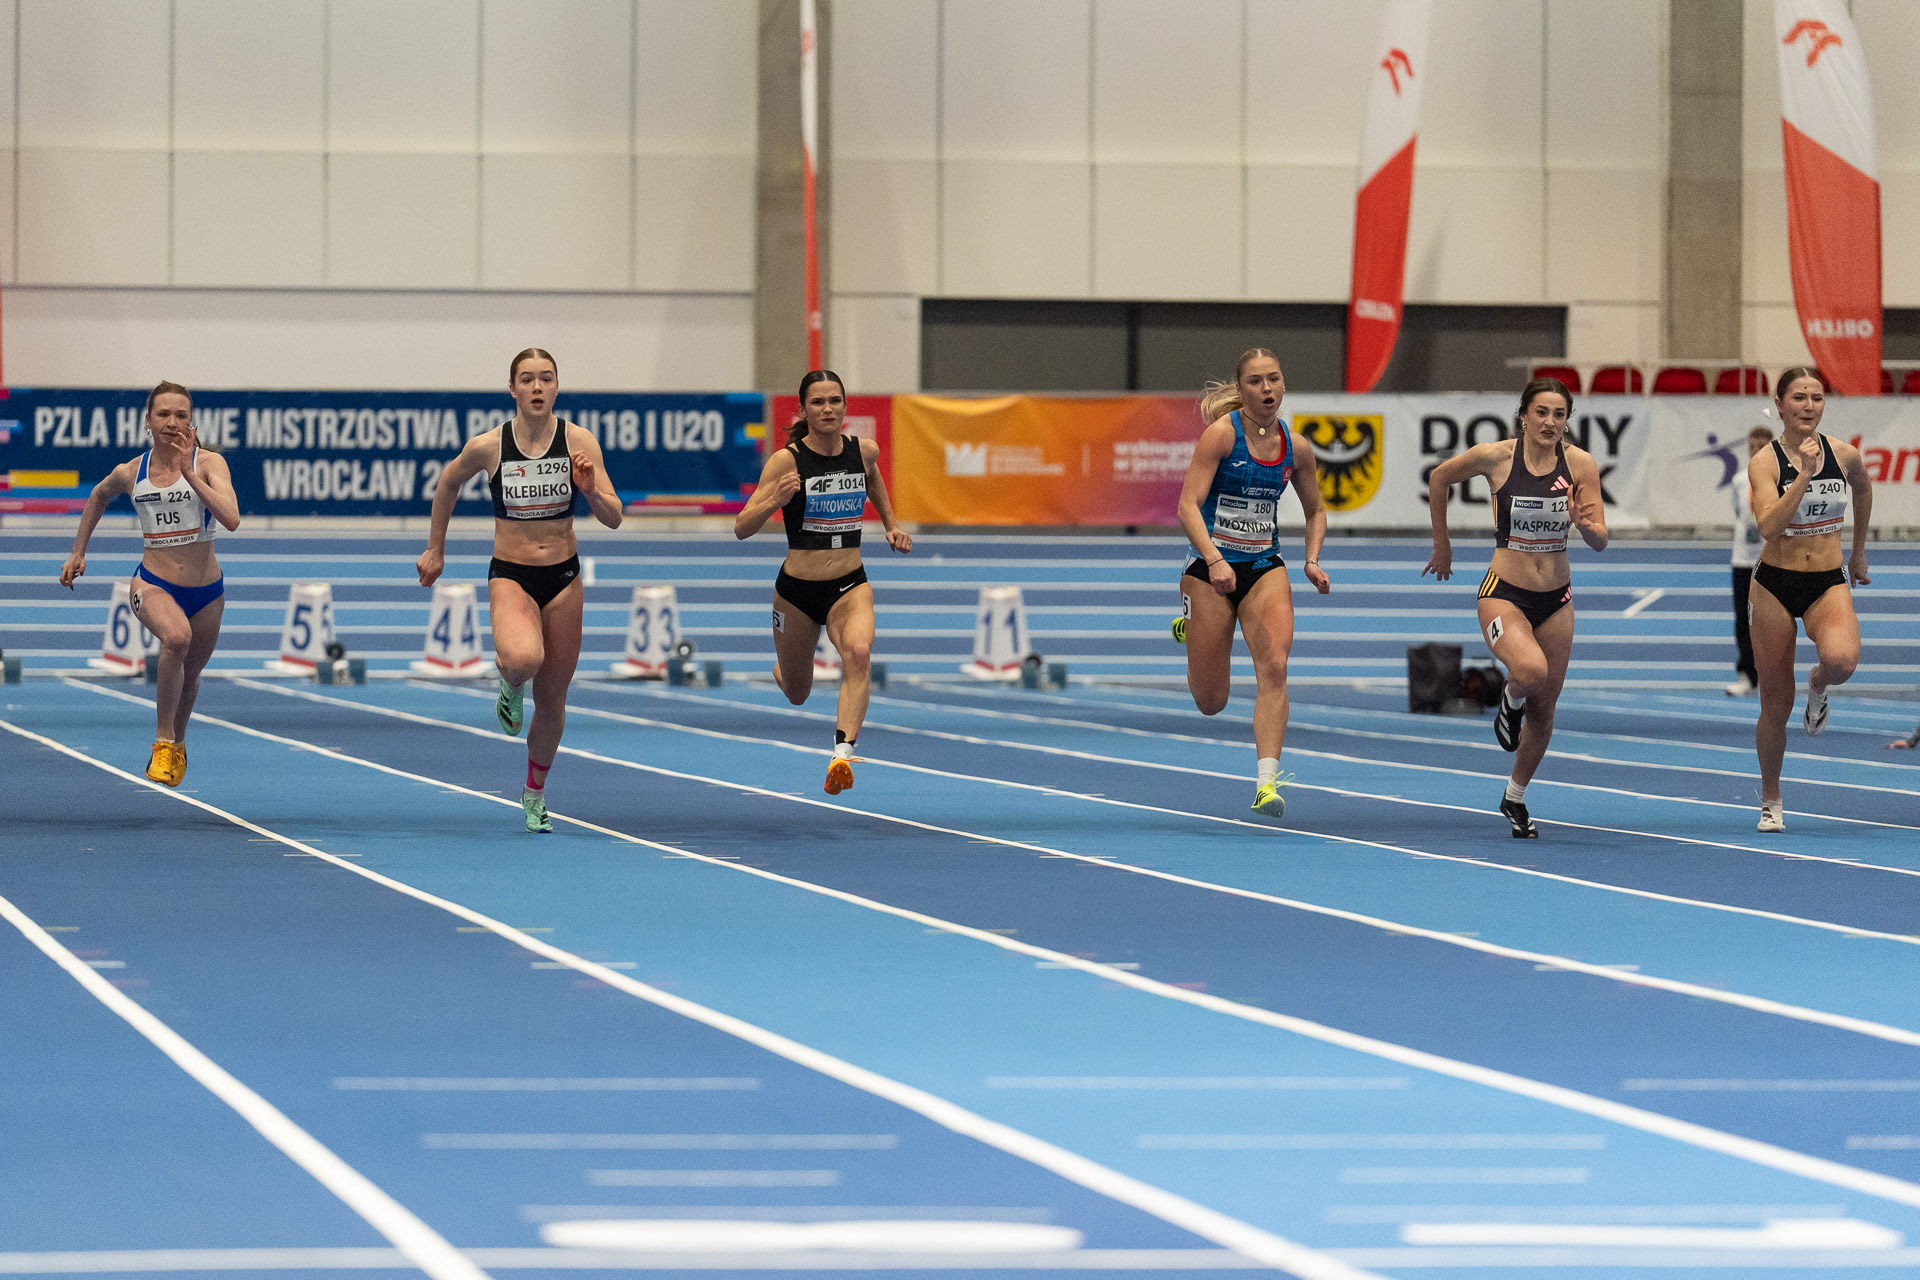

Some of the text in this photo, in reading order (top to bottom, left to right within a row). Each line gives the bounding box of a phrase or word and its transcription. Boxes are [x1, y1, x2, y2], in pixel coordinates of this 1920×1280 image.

[34, 406, 109, 447] PZLA
[116, 407, 241, 448] HAWE
[246, 408, 460, 449] MISTRZOSTWA
[645, 410, 656, 451] I
[662, 410, 725, 451] U20
[536, 461, 569, 475] 1296
[263, 459, 416, 500] WROCŁAW
[838, 477, 865, 491] 1014
[1819, 482, 1841, 495] 240
[168, 490, 191, 503] 224
[505, 482, 569, 499] KLEBIEKO
[1241, 486, 1281, 497] VECTRA
[808, 497, 862, 513] ŻUKOWSKA
[1254, 502, 1271, 514] 180
[1806, 500, 1828, 516] JEŻ
[156, 511, 181, 526] FUS
[133, 593, 140, 612] 8
[1183, 595, 1189, 616] 5
[112, 603, 131, 649] 6
[290, 603, 312, 651] 5
[433, 606, 451, 653] 4
[461, 606, 475, 651] 4
[633, 607, 651, 653] 3
[659, 606, 675, 653] 3
[981, 609, 993, 655] 1
[1004, 607, 1018, 655] 1
[1492, 620, 1500, 640] 4
